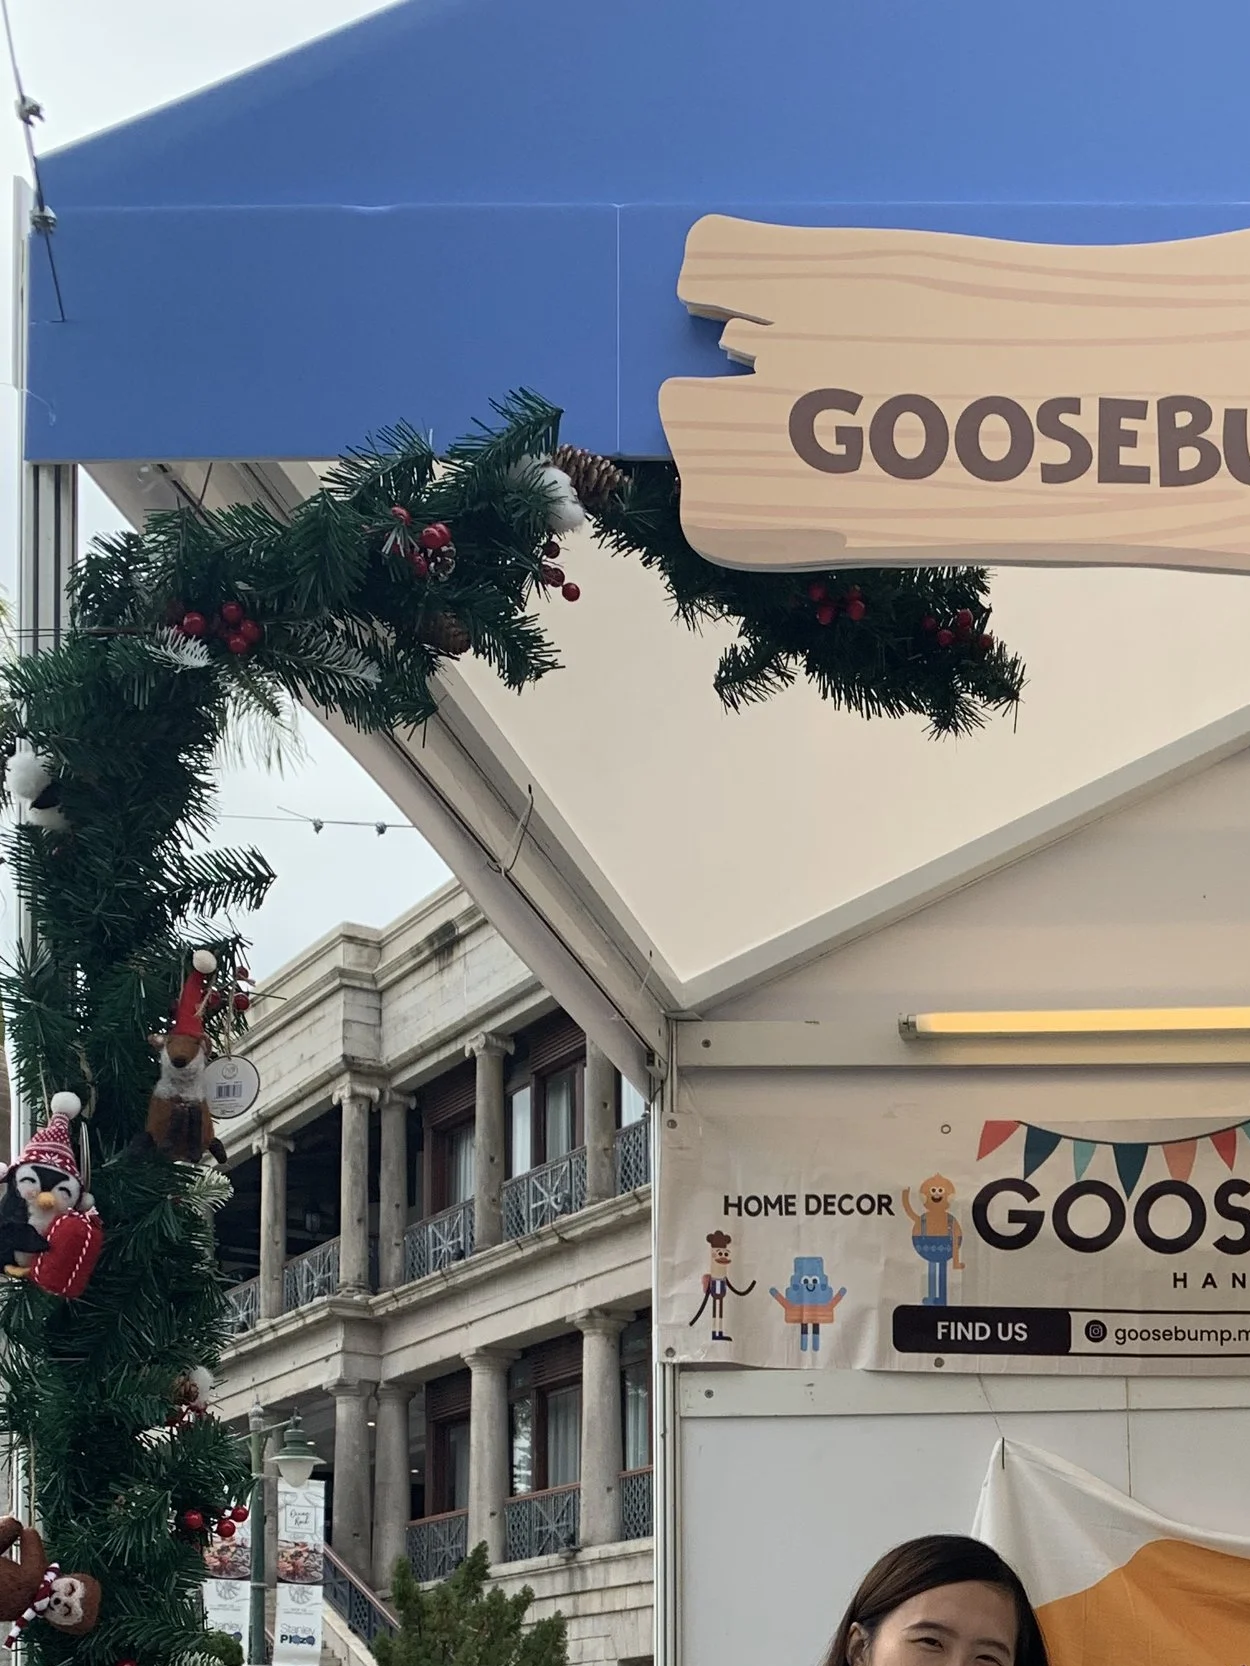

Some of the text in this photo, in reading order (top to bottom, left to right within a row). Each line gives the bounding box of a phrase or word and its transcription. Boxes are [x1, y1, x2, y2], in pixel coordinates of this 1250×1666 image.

[723, 1193, 896, 1218] HOME DECOR
[936, 1320, 1029, 1343] FIND US
[280, 1623, 316, 1636] Stanley
